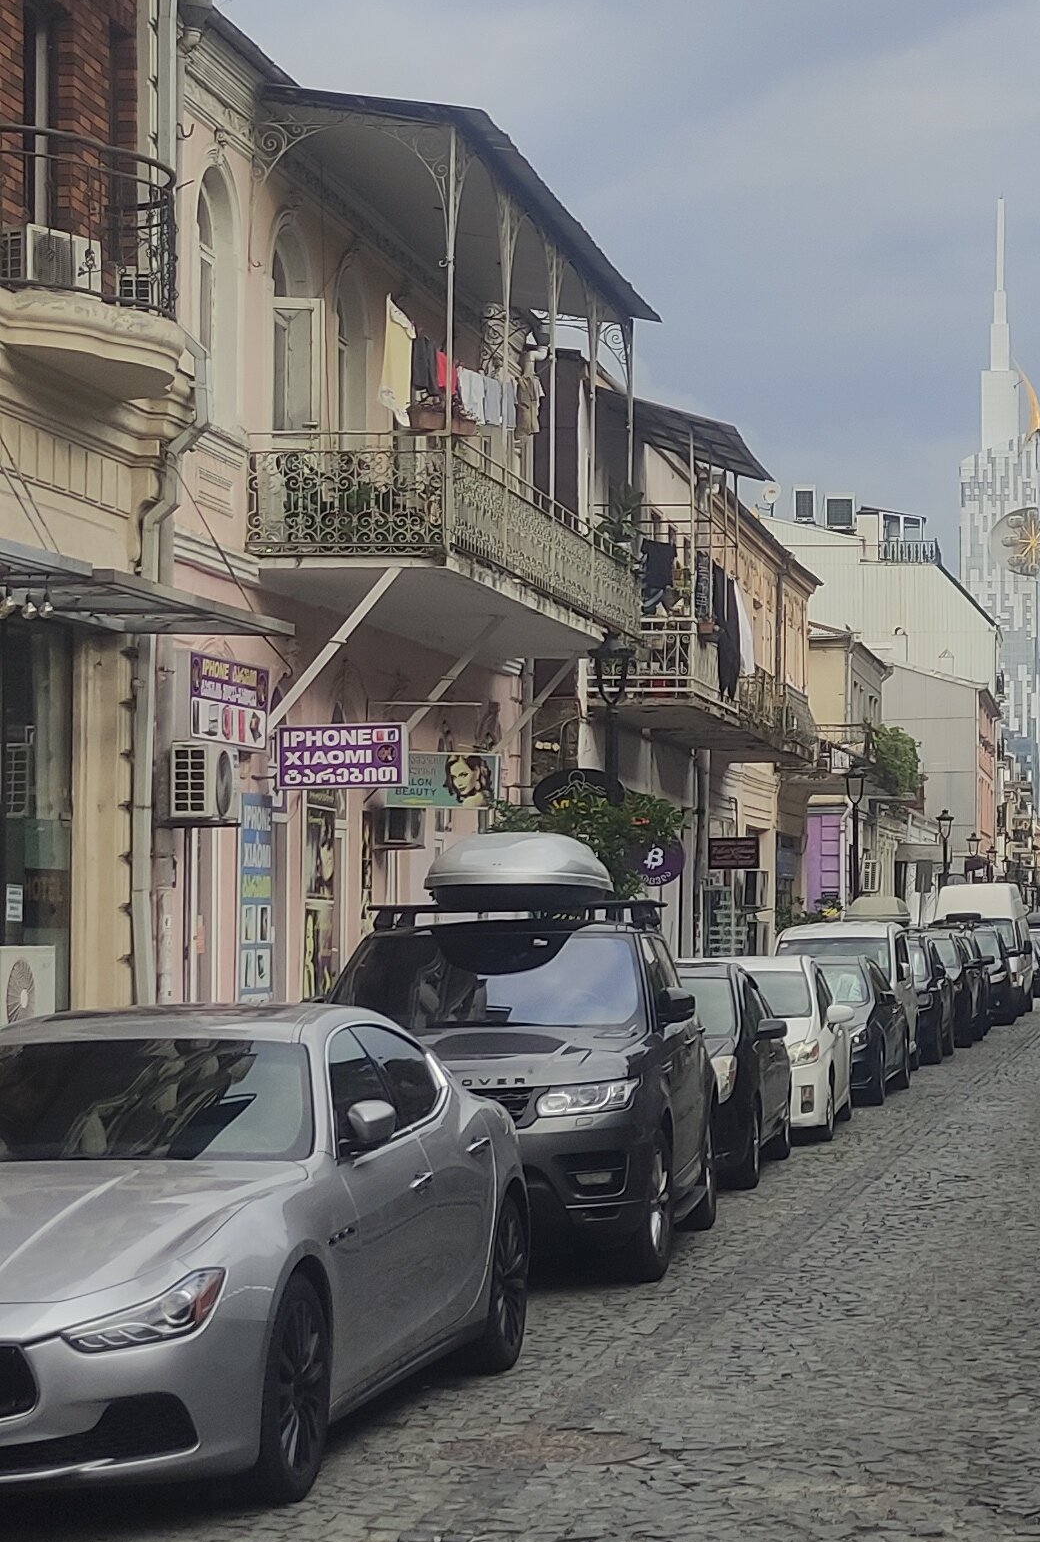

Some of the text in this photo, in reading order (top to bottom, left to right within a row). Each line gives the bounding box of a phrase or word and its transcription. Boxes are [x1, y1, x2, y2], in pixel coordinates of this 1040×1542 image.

[202, 658, 230, 680] IPHONE
[283, 728, 373, 748] IPHONE
[284, 749, 373, 766] XIAOMI
[284, 766, 398, 784] ტარებით
[408, 778, 432, 787] LON
[395, 788, 437, 796] BEAUTY
[243, 805, 272, 831] IPHONE
[243, 842, 272, 868] XIAOMI
[462, 1077, 526, 1087] OVER
